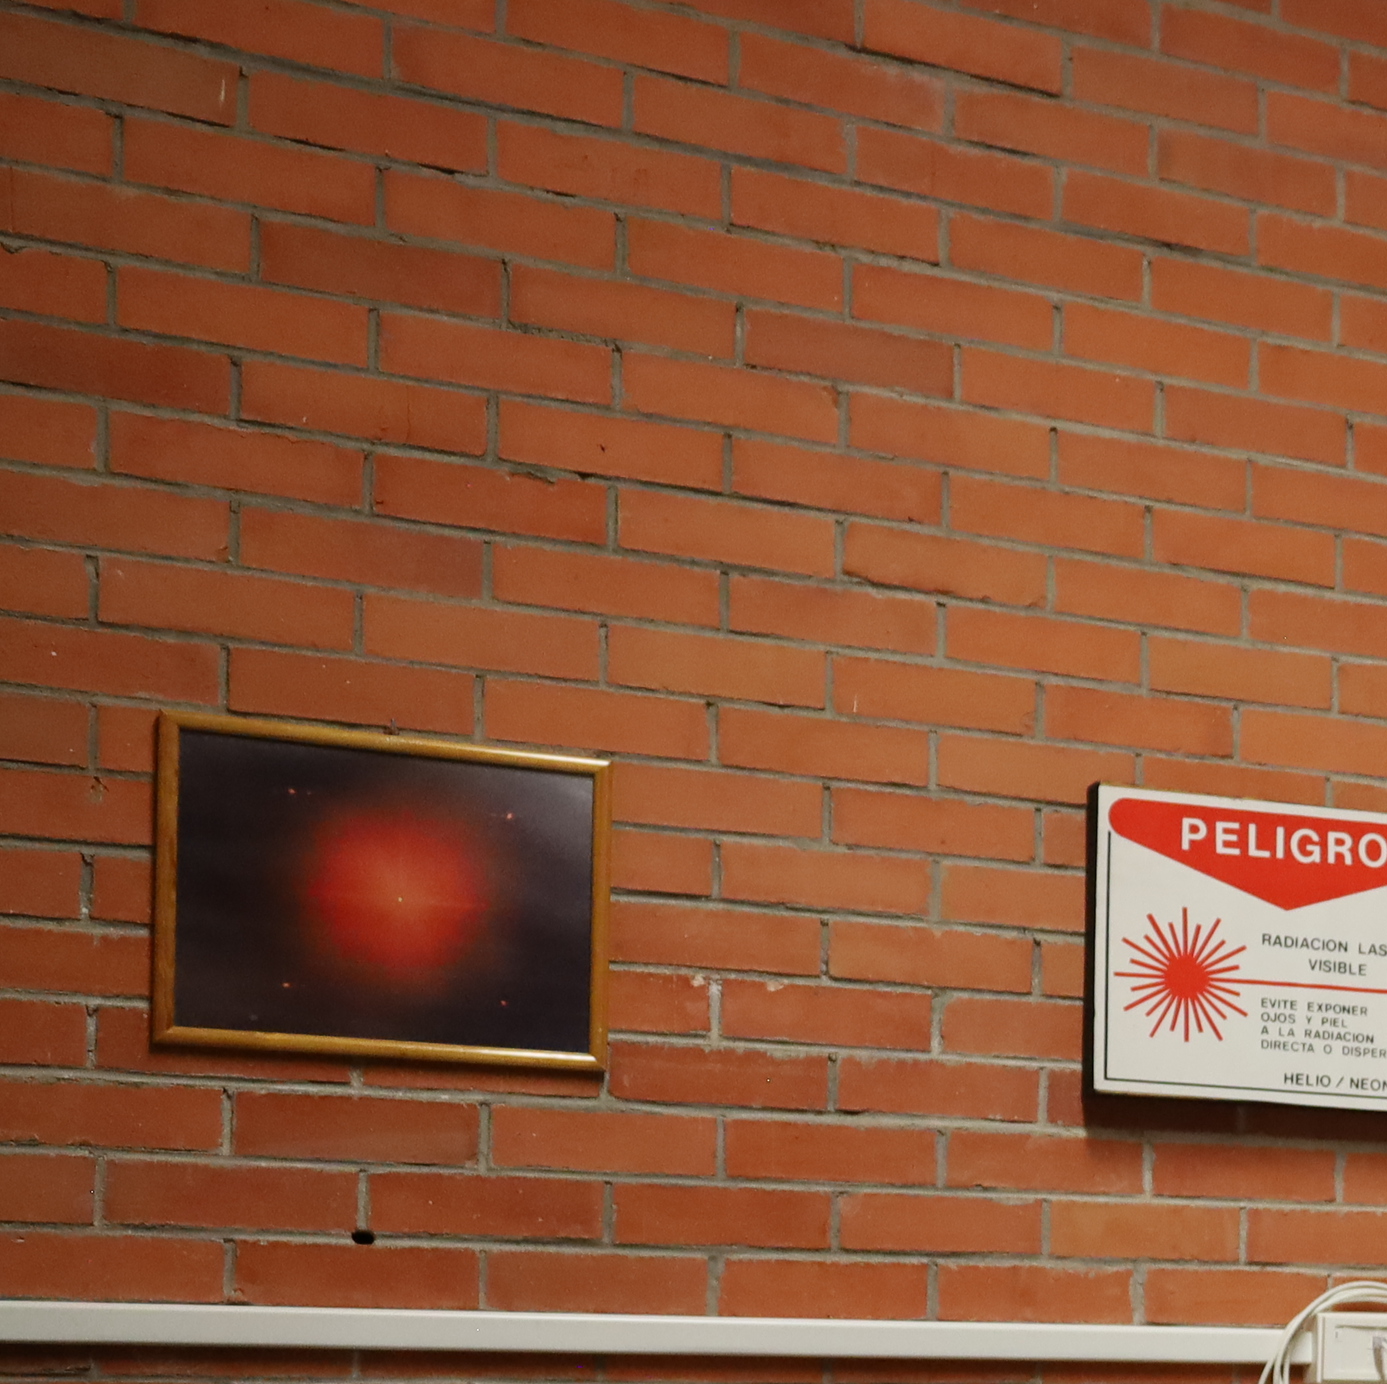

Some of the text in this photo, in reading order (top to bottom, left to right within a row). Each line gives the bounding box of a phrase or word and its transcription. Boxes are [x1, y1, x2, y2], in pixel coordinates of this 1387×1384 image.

[1261, 933, 1349, 953] RADIACION
[1308, 958, 1368, 977] VISIBLE
[1260, 997, 1368, 1016] EVITE EXPONER
[1260, 1011, 1348, 1029] OJOS Y PIEL
[1260, 1025, 1375, 1044] A LA RADIACION
[1260, 1039, 1315, 1053] DIRECTA
[1323, 1043, 1333, 1055] O
[1283, 1072, 1331, 1088] HELIO
